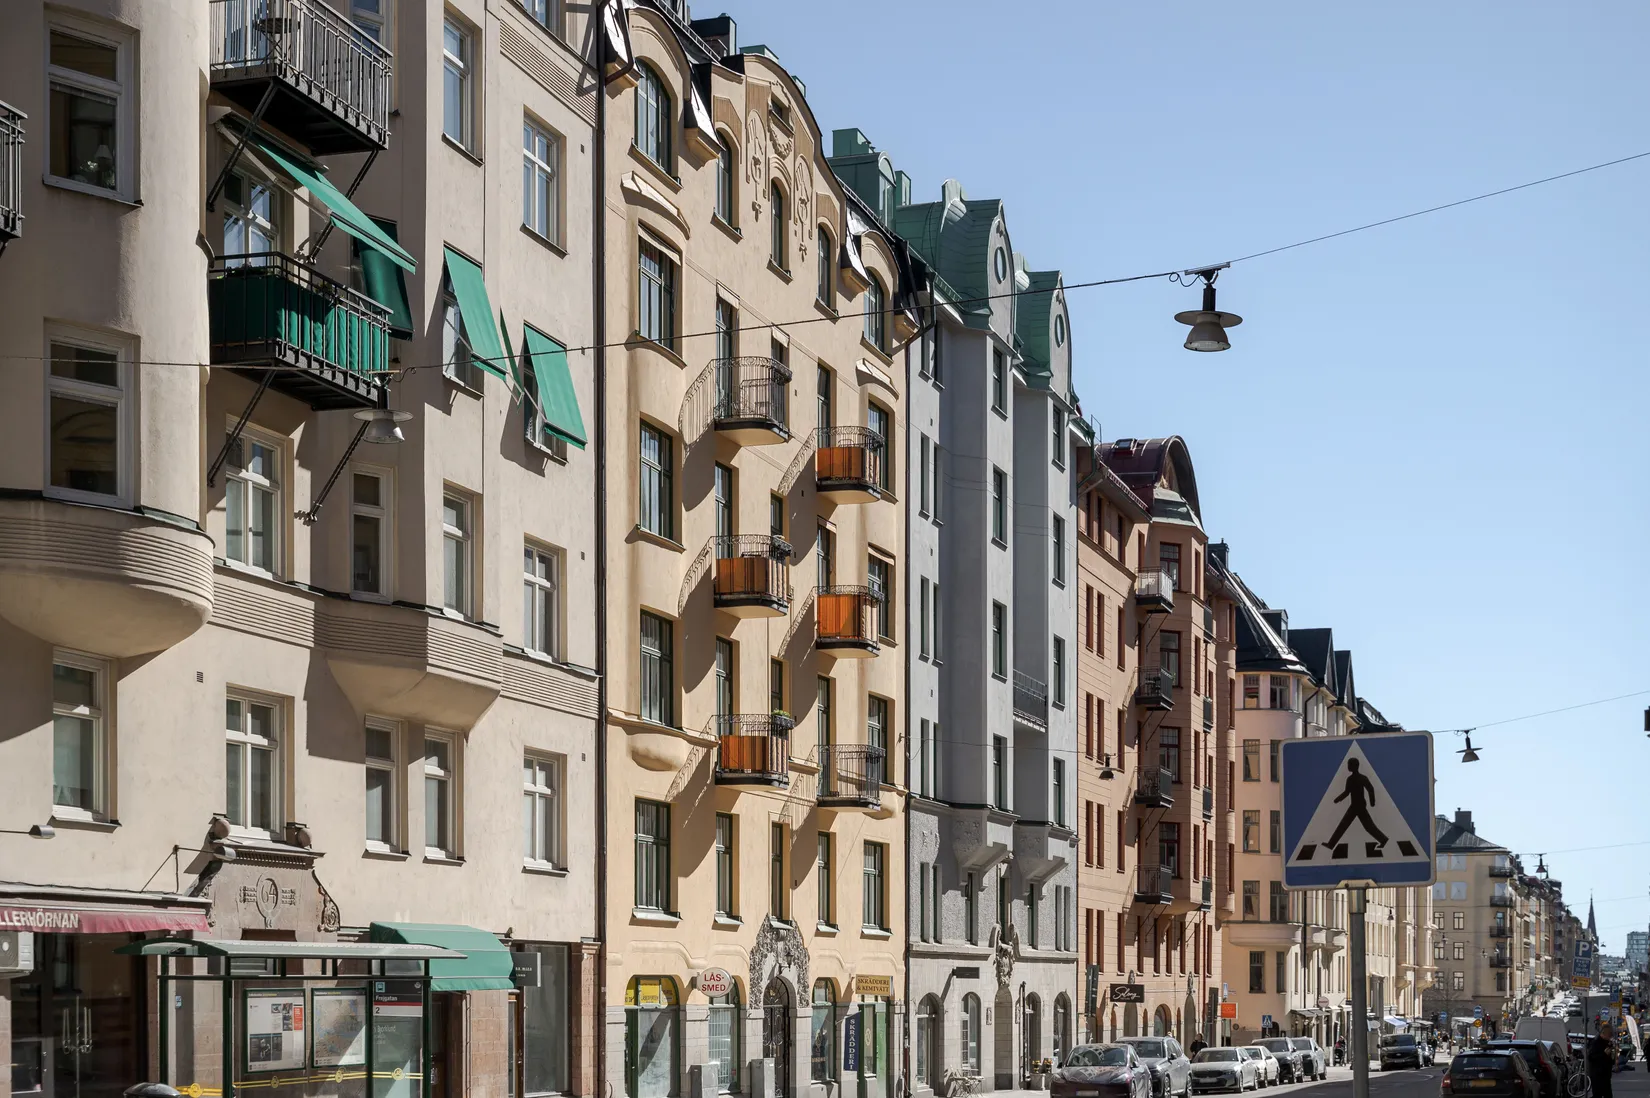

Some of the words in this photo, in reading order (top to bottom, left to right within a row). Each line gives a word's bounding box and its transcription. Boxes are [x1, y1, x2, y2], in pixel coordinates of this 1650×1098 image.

[1578, 941, 1590, 956] P
[704, 972, 724, 981] LÅS-
[375, 1006, 380, 1014] 2
[848, 1019, 856, 1070] SKRÄDDERI
